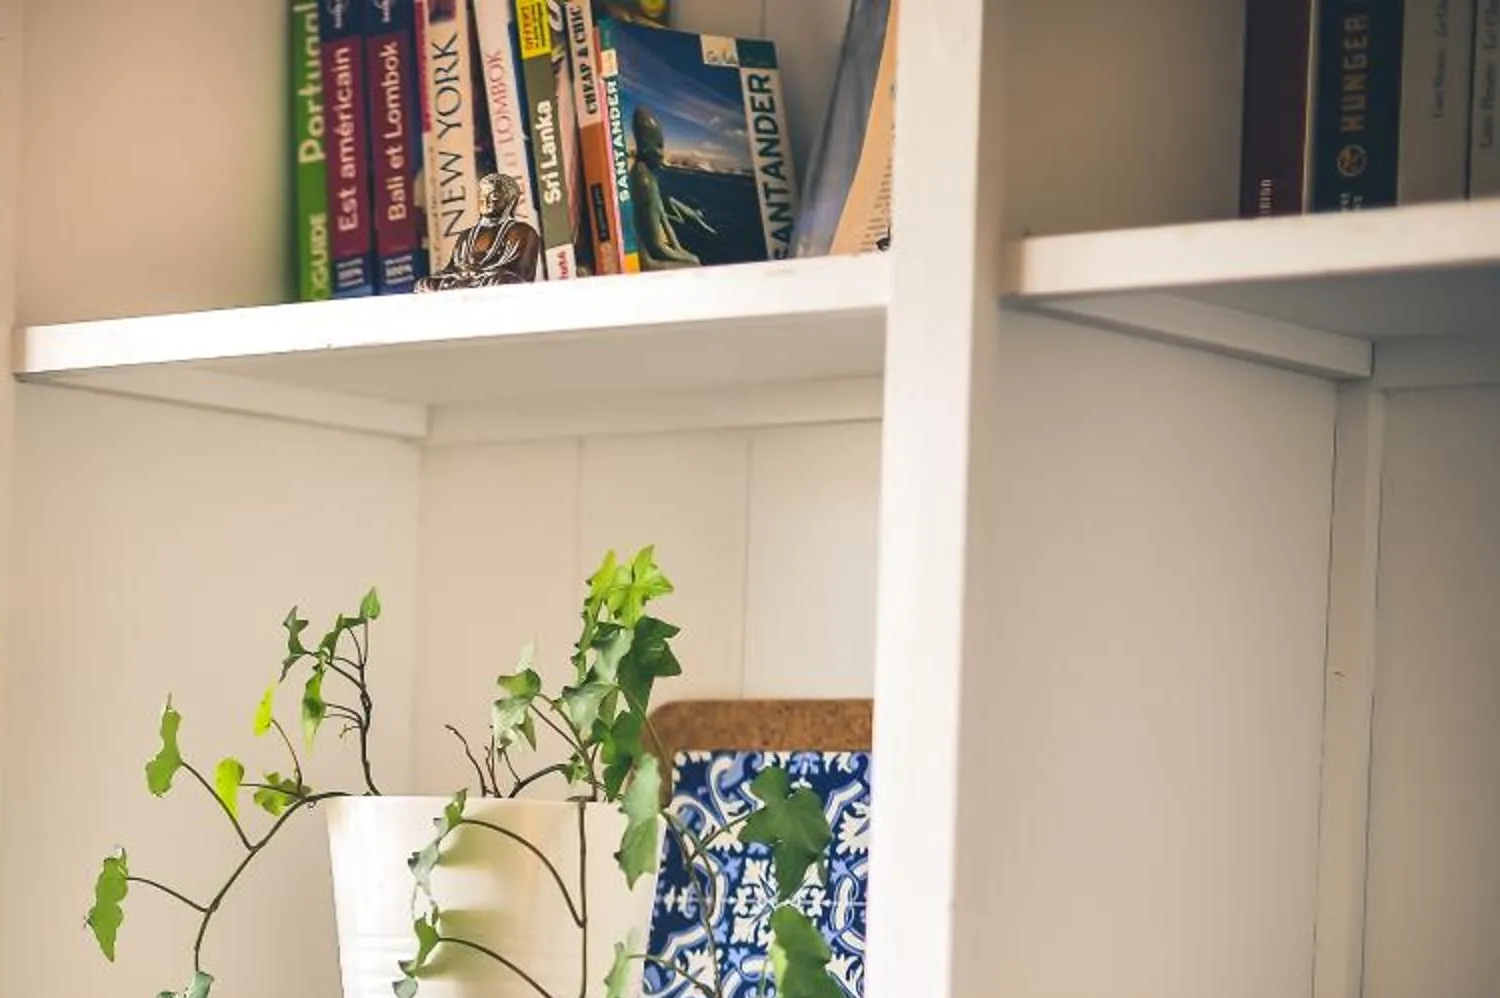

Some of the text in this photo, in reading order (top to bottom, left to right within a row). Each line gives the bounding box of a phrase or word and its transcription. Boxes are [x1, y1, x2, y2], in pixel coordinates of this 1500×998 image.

[569, 5, 586, 44] CHIC
[330, 46, 356, 179] américain
[378, 41, 403, 139] Lombok
[430, 33, 462, 138] YORK
[484, 50, 513, 144] LOMBOK
[576, 63, 598, 115] CHEAP
[1339, 13, 1368, 132] HUNGER
[386, 143, 404, 169] et
[535, 101, 563, 204] Sri Lanka
[605, 80, 630, 202] SANTANDER
[337, 185, 360, 232] Est
[386, 176, 407, 222] Bali
[437, 150, 466, 237] NEW
